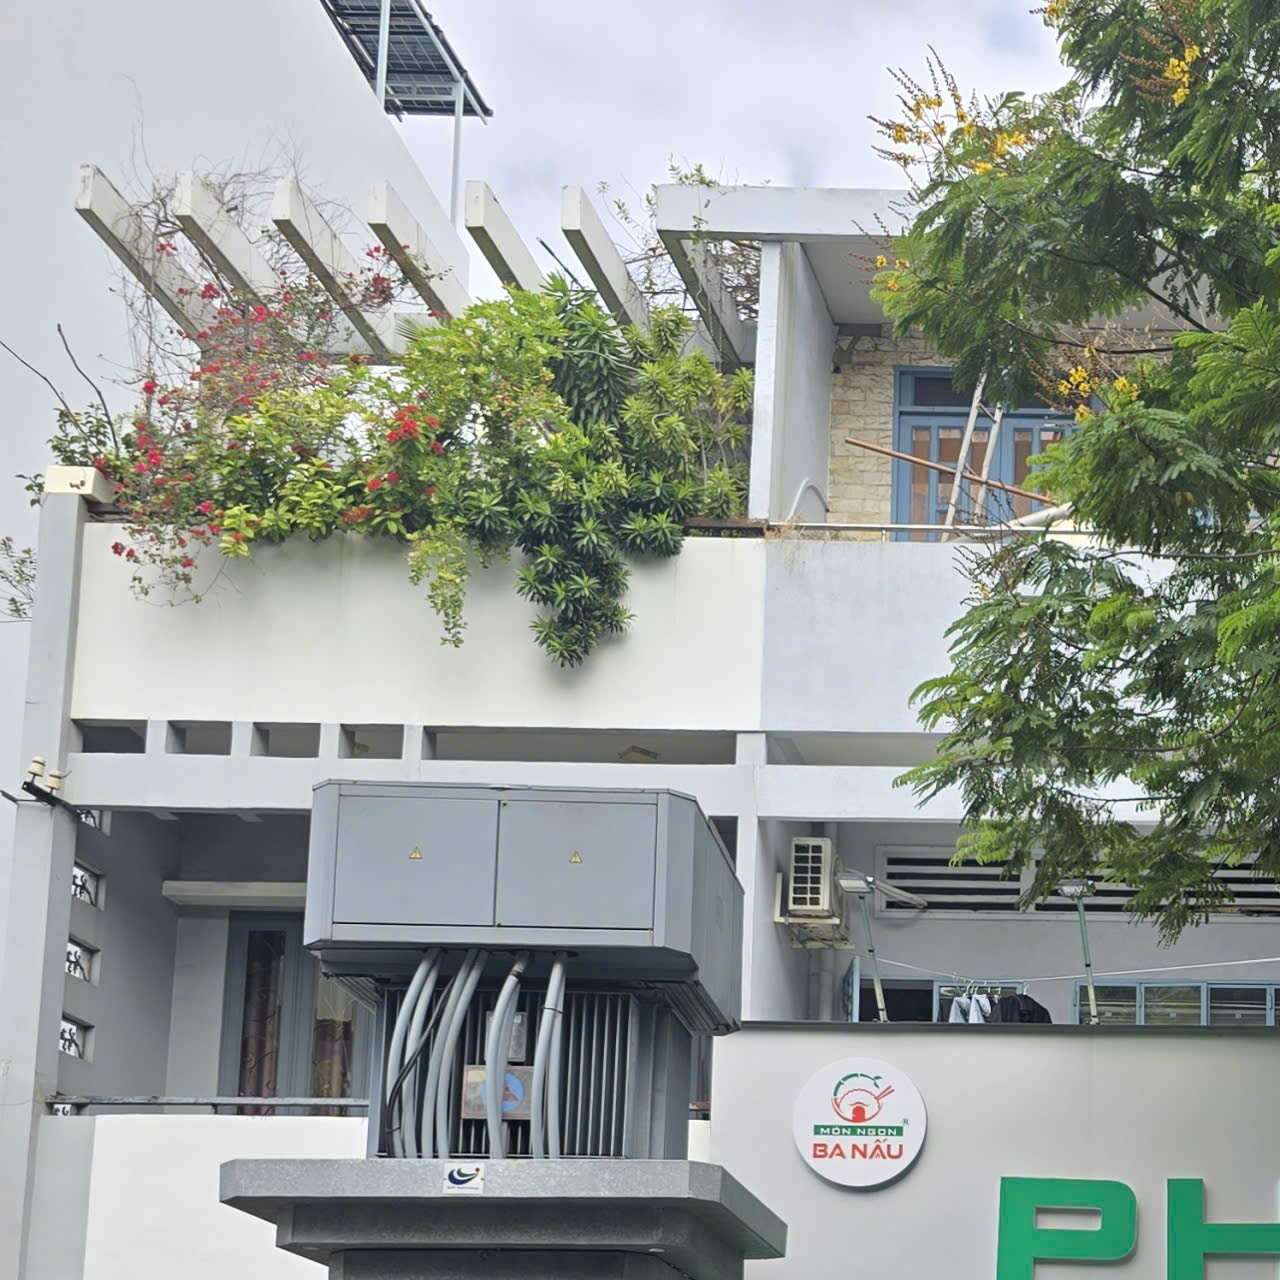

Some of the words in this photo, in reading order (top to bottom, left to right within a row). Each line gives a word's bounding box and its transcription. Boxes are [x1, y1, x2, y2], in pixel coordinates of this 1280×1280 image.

[857, 1126, 897, 1136] NGON
[812, 1143, 846, 1159] BA
[851, 1138, 904, 1159] NẤU
